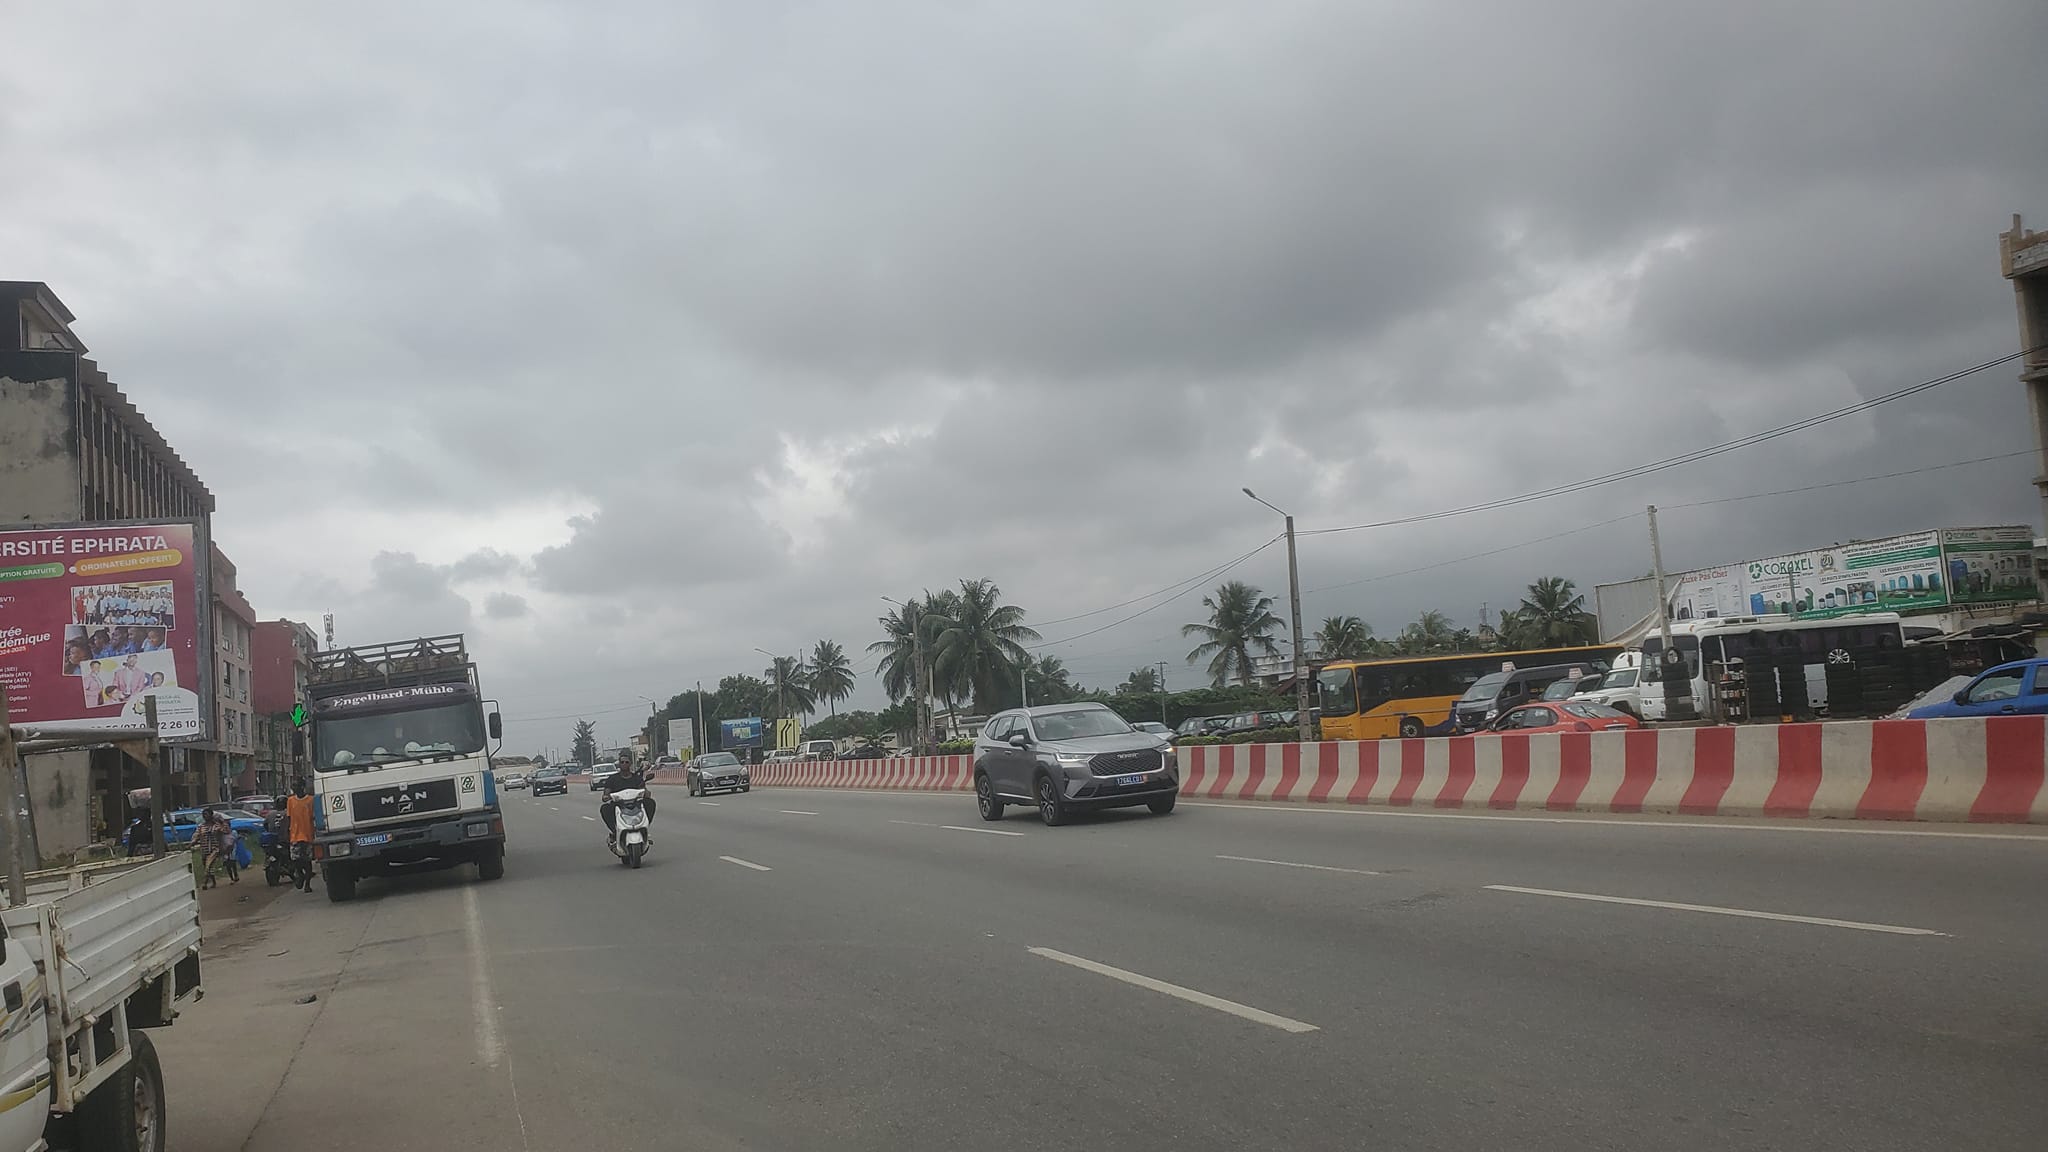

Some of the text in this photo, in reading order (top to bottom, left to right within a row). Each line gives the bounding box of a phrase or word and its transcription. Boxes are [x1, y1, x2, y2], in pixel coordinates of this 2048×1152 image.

[71, 535, 169, 554] EPHRATA
[80, 554, 173, 572] ORDINATEUR OFFERT
[1763, 558, 1814, 575] CORAXEL
[22, 567, 57, 576] GRATUITE
[1699, 573, 1711, 581] Pas
[1712, 569, 1728, 578] Cher
[169, 720, 182, 729] 26
[186, 720, 197, 728] 10
[381, 791, 428, 805] MAN
